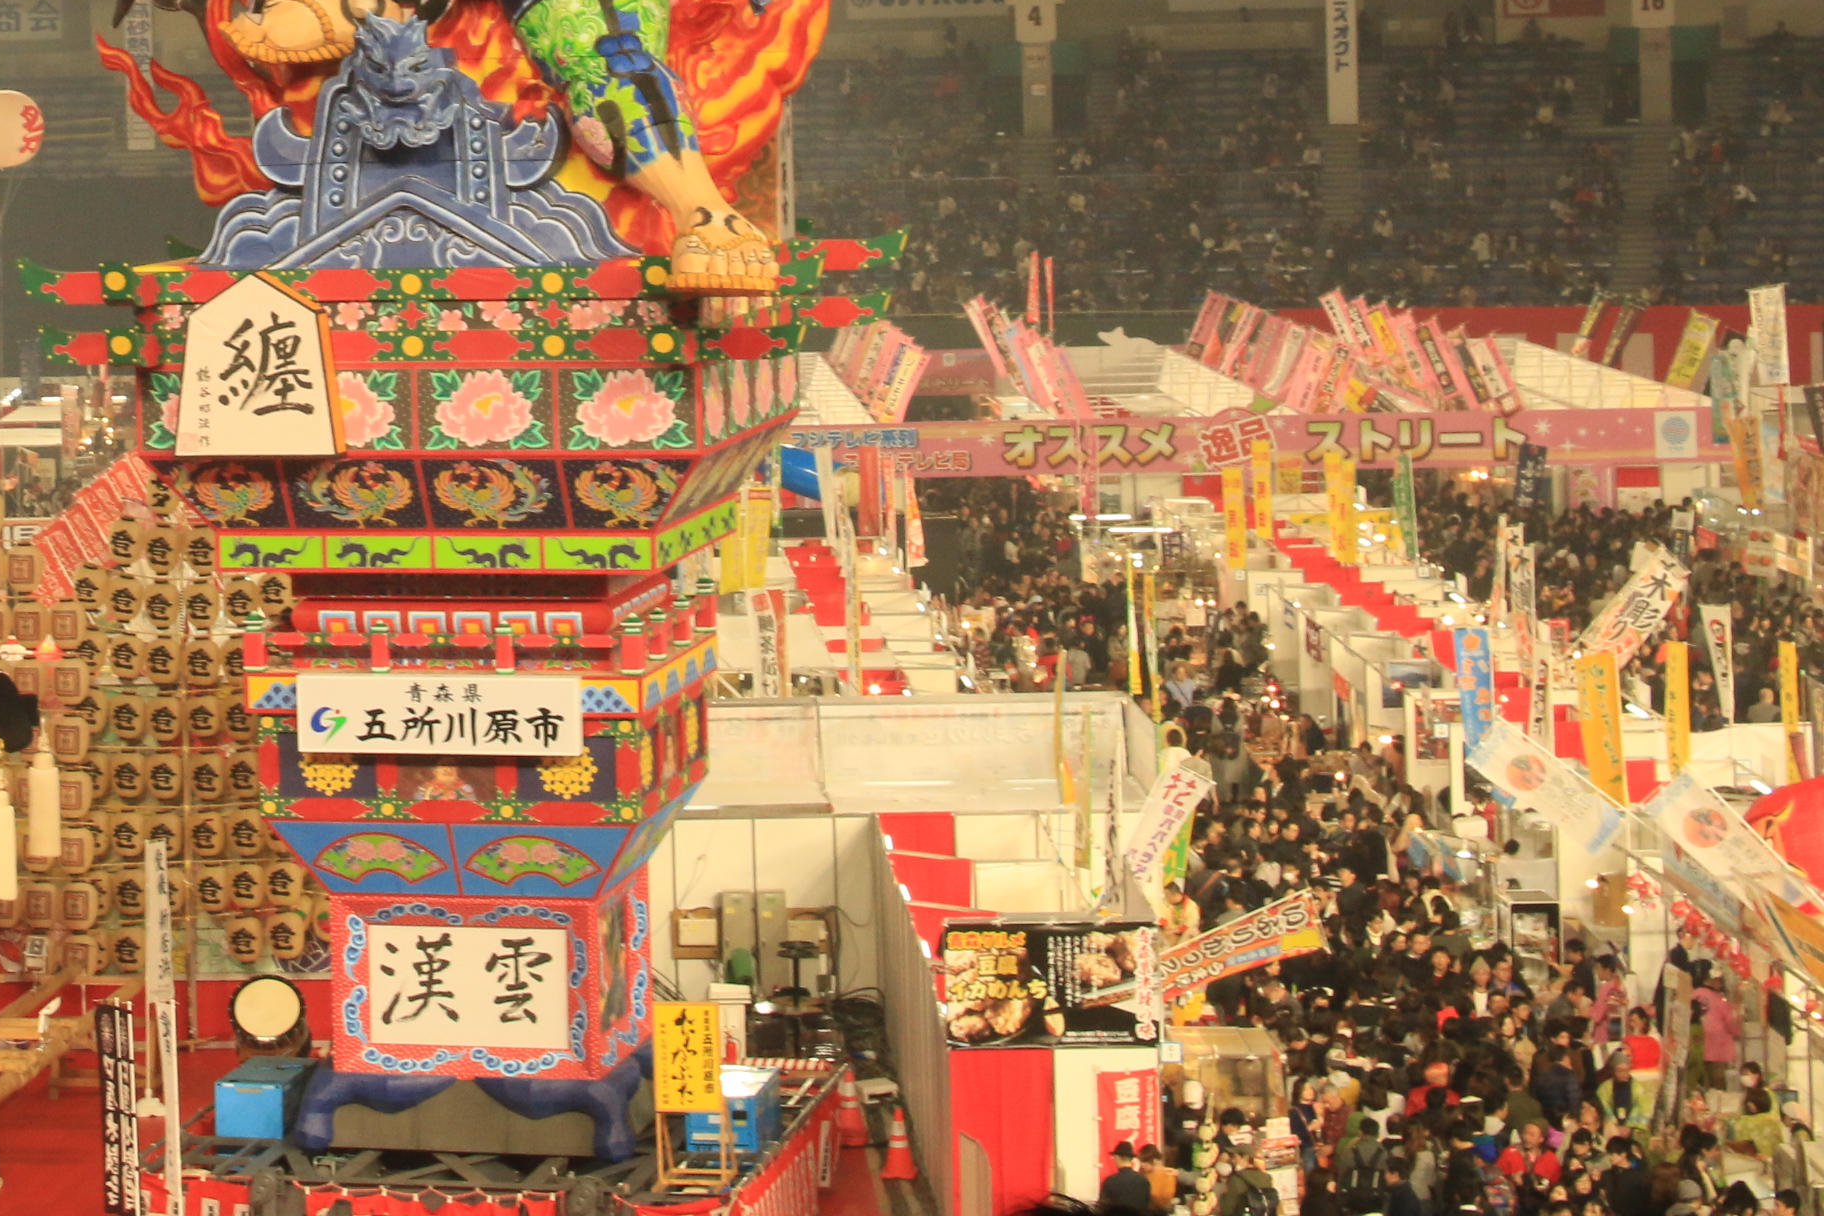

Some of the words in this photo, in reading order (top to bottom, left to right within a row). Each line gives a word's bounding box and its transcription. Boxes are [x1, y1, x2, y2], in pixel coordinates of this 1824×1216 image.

[1029, 6, 1042, 25] 4
[790, 428, 918, 449] フジテレビ系列
[1003, 425, 1177, 468] オススメ
[1200, 415, 1274, 466] 逸品
[1306, 417, 1529, 464] ストリート
[405, 682, 482, 703] 青森県
[356, 706, 565, 748] 五所川原市
[1163, 773, 1197, 807] 花
[950, 979, 1048, 1000] イカめんち
